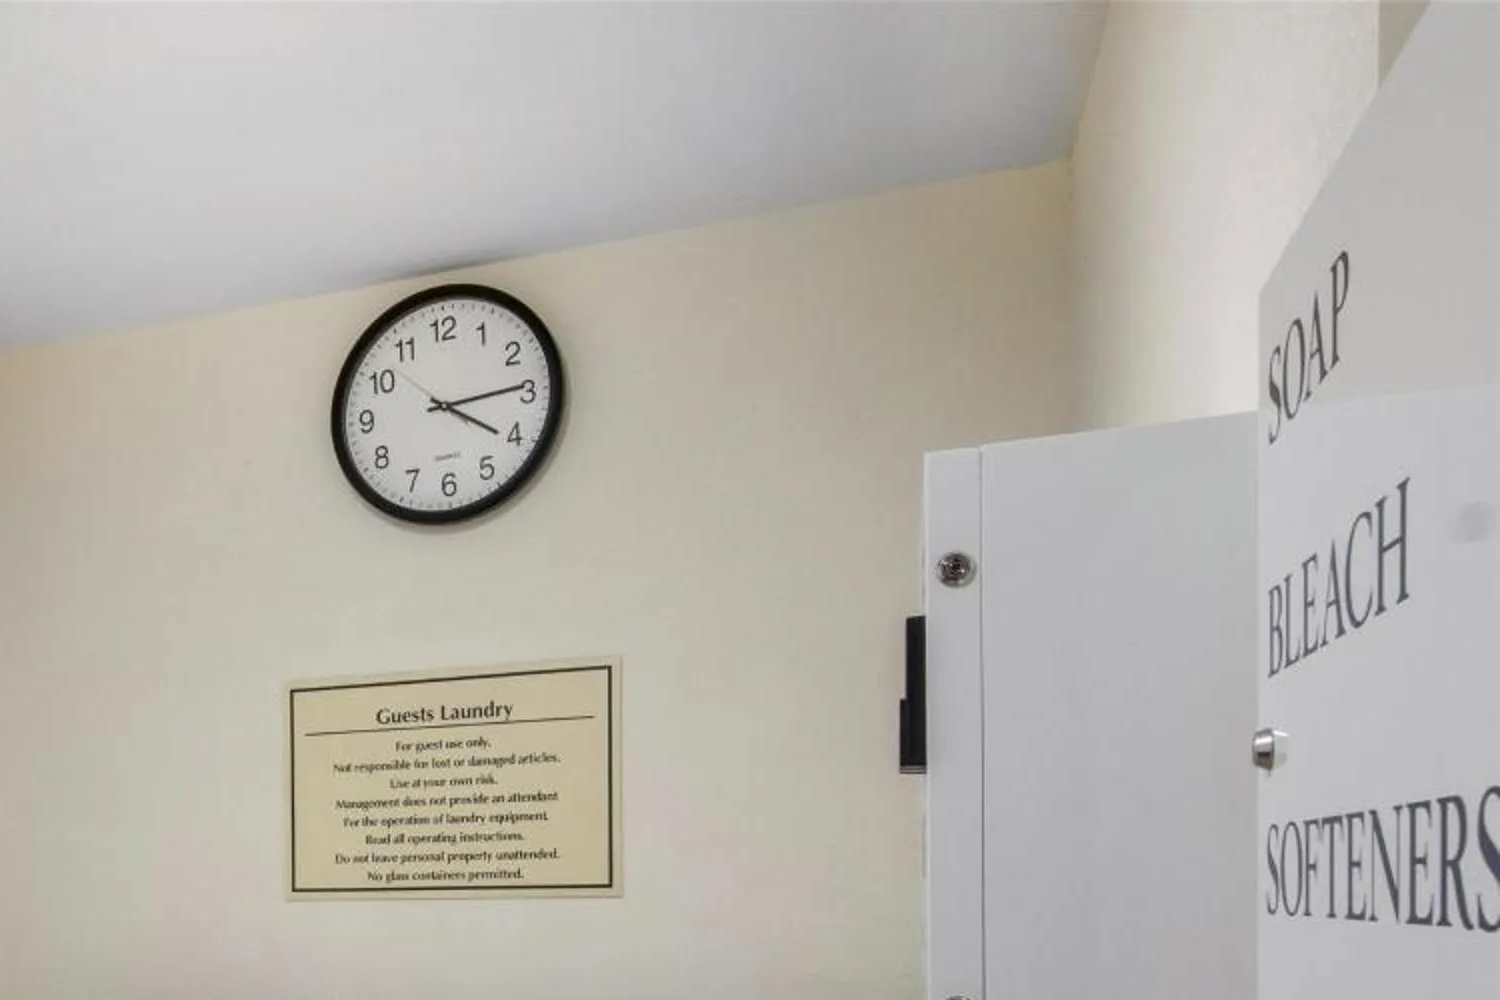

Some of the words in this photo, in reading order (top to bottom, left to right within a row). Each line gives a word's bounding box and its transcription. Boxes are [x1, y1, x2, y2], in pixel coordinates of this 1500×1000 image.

[430, 315, 457, 343] 12
[476, 322, 486, 346] 1
[395, 337, 415, 362] 11
[504, 341, 521, 366] 2
[1268, 250, 1350, 444] SOAP
[369, 369, 396, 394] 10
[519, 379, 536, 404] 3
[359, 409, 375, 434] 9
[507, 422, 522, 446] 4
[374, 445, 389, 469] 8
[479, 455, 495, 480] 5
[405, 468, 420, 493] 7
[441, 472, 457, 497] 6
[1267, 476, 1410, 678] BLEACH
[375, 706, 435, 725] Guests
[440, 700, 514, 721] Laundry
[395, 741, 411, 752] For
[415, 740, 442, 753] guest
[333, 763, 350, 772] Not
[354, 760, 411, 774] responsible
[468, 756, 516, 768] damaged
[335, 798, 401, 812] Management
[402, 797, 427, 806] does
[429, 796, 446, 805] not
[449, 793, 488, 808] provide
[507, 791, 559, 803] attendant
[380, 814, 431, 828] operation
[446, 812, 486, 824] laundry
[365, 834, 391, 844] Read
[407, 832, 457, 846] operating
[371, 852, 399, 863] leave
[400, 851, 445, 865] personal
[447, 851, 492, 865] property
[1265, 785, 1500, 932] SOFTENERS
[367, 872, 383, 881] No
[385, 870, 410, 884] glass
[412, 870, 466, 881] containers
